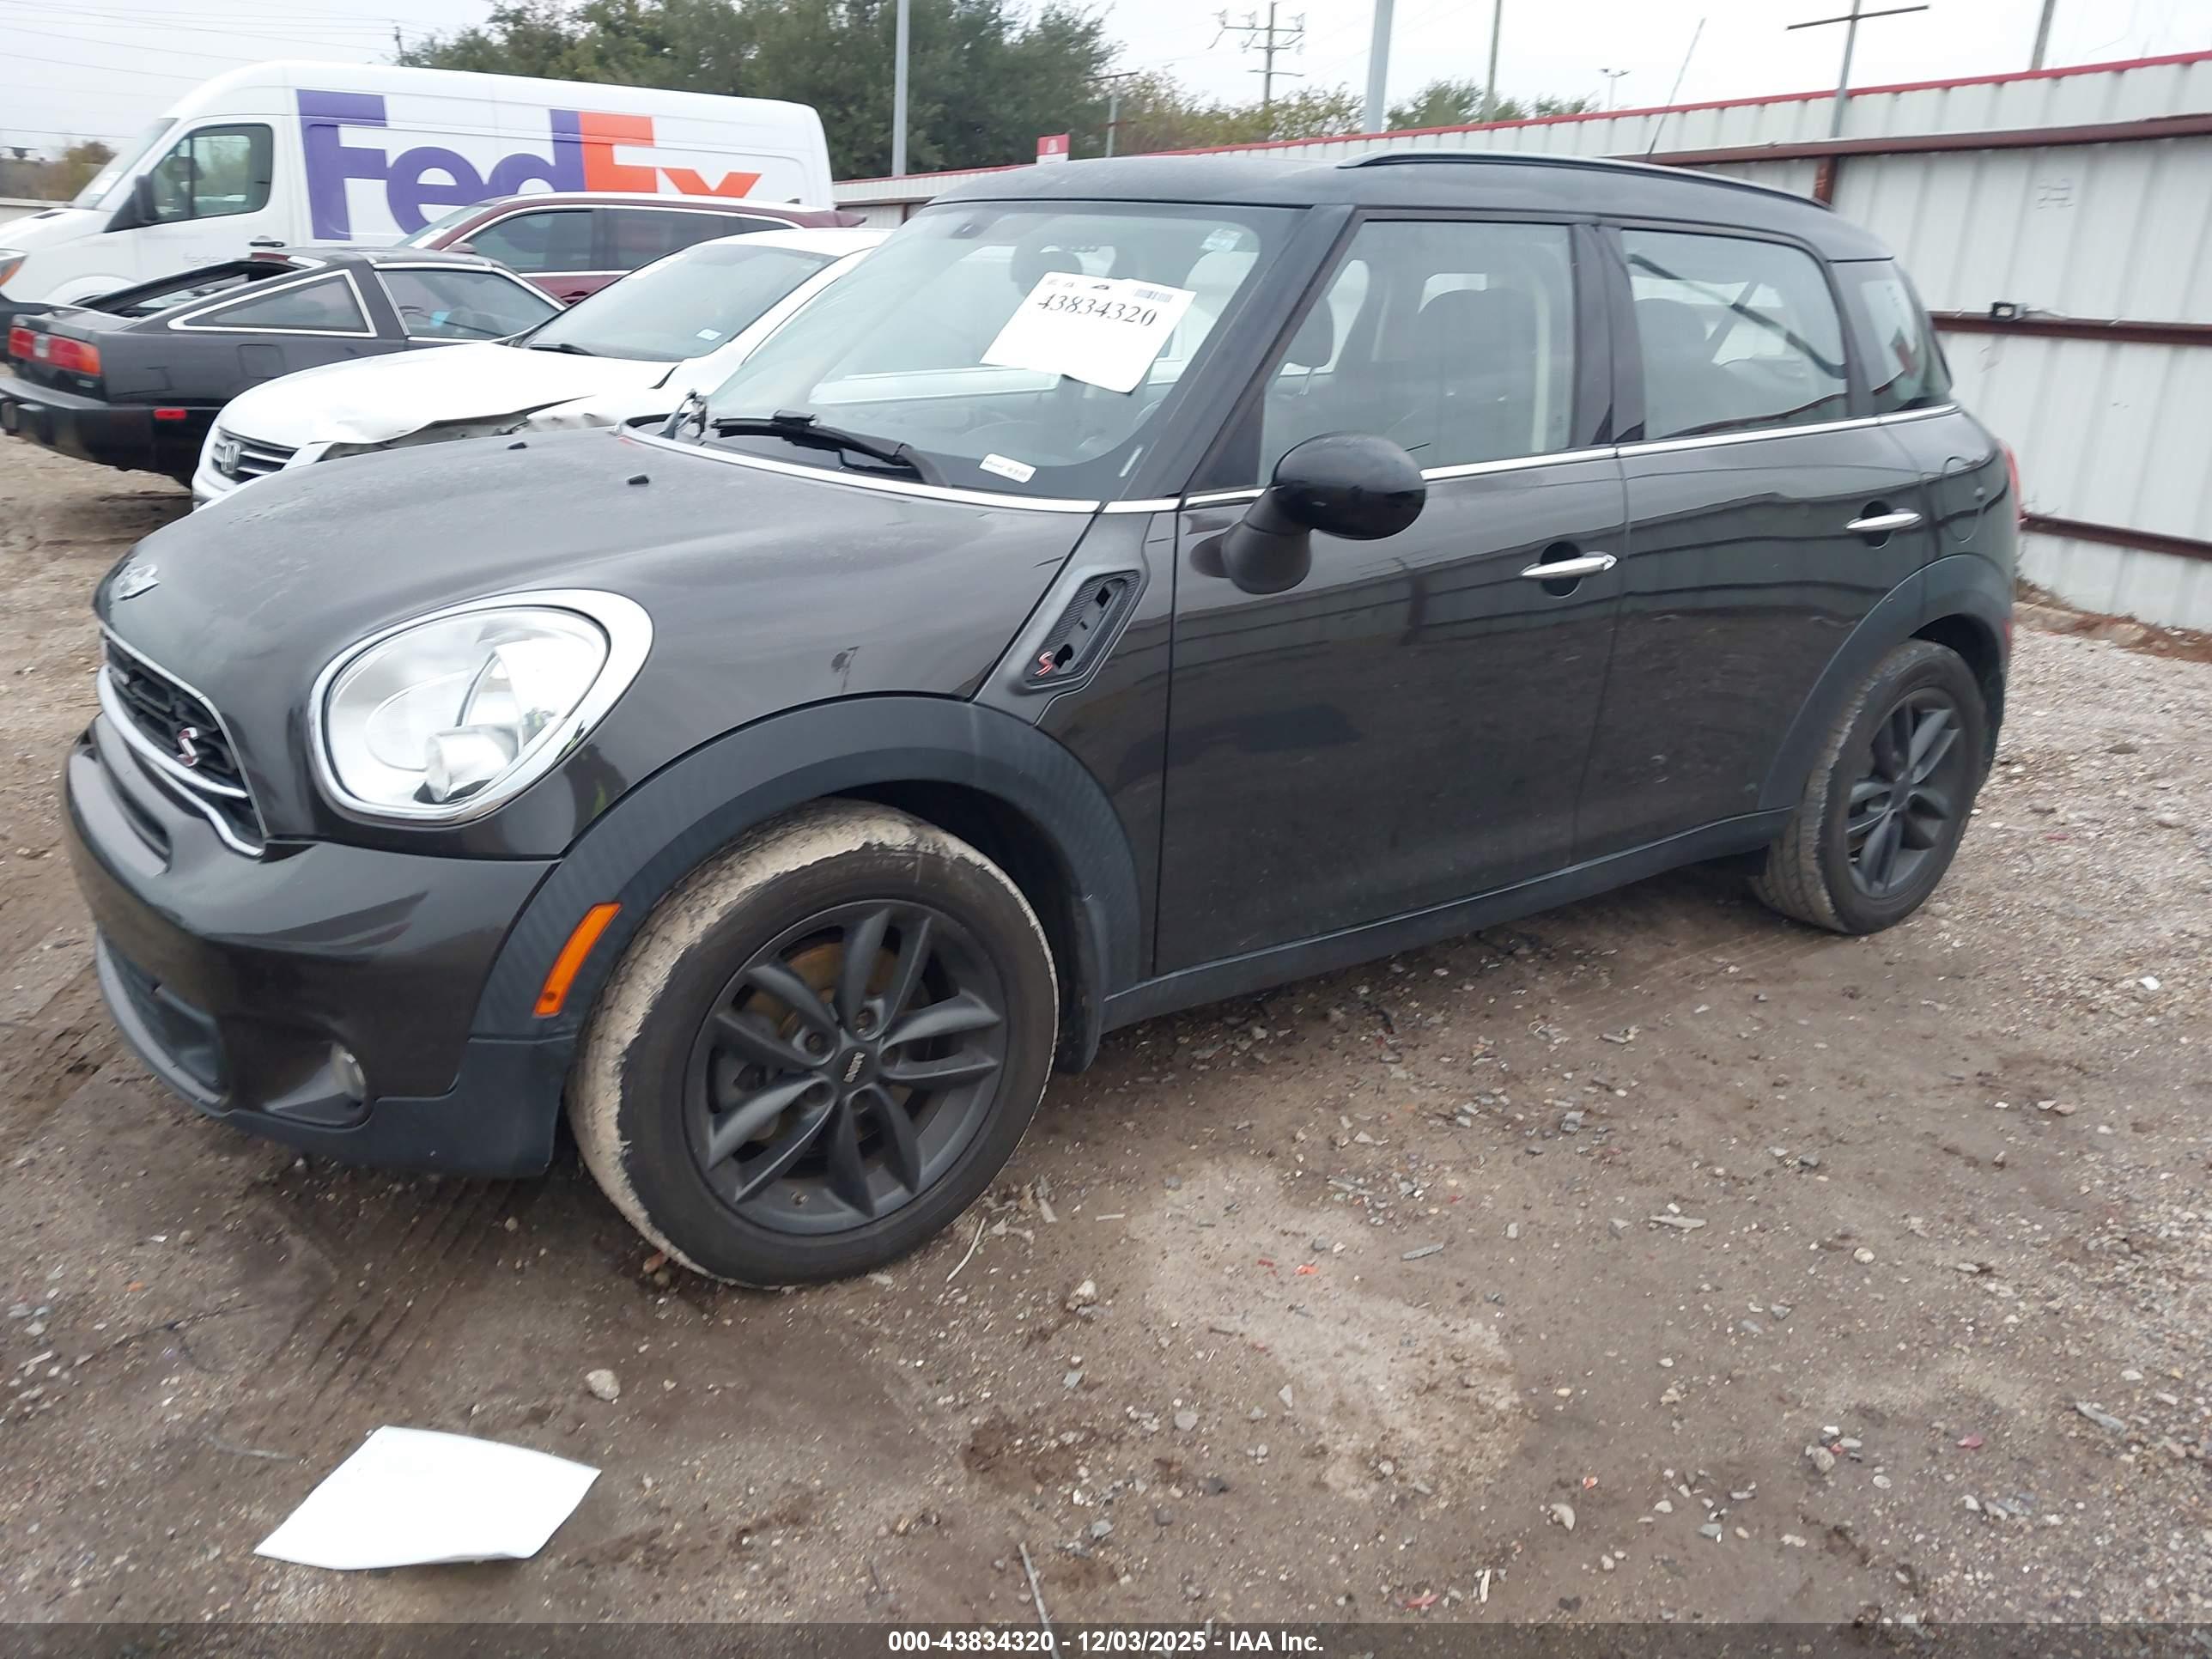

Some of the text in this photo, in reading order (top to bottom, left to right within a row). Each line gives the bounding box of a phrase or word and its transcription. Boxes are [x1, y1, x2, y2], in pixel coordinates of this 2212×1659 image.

[1036, 293, 1158, 327] 43834320
[1034, 650, 1054, 678] S
[177, 726, 198, 768] S
